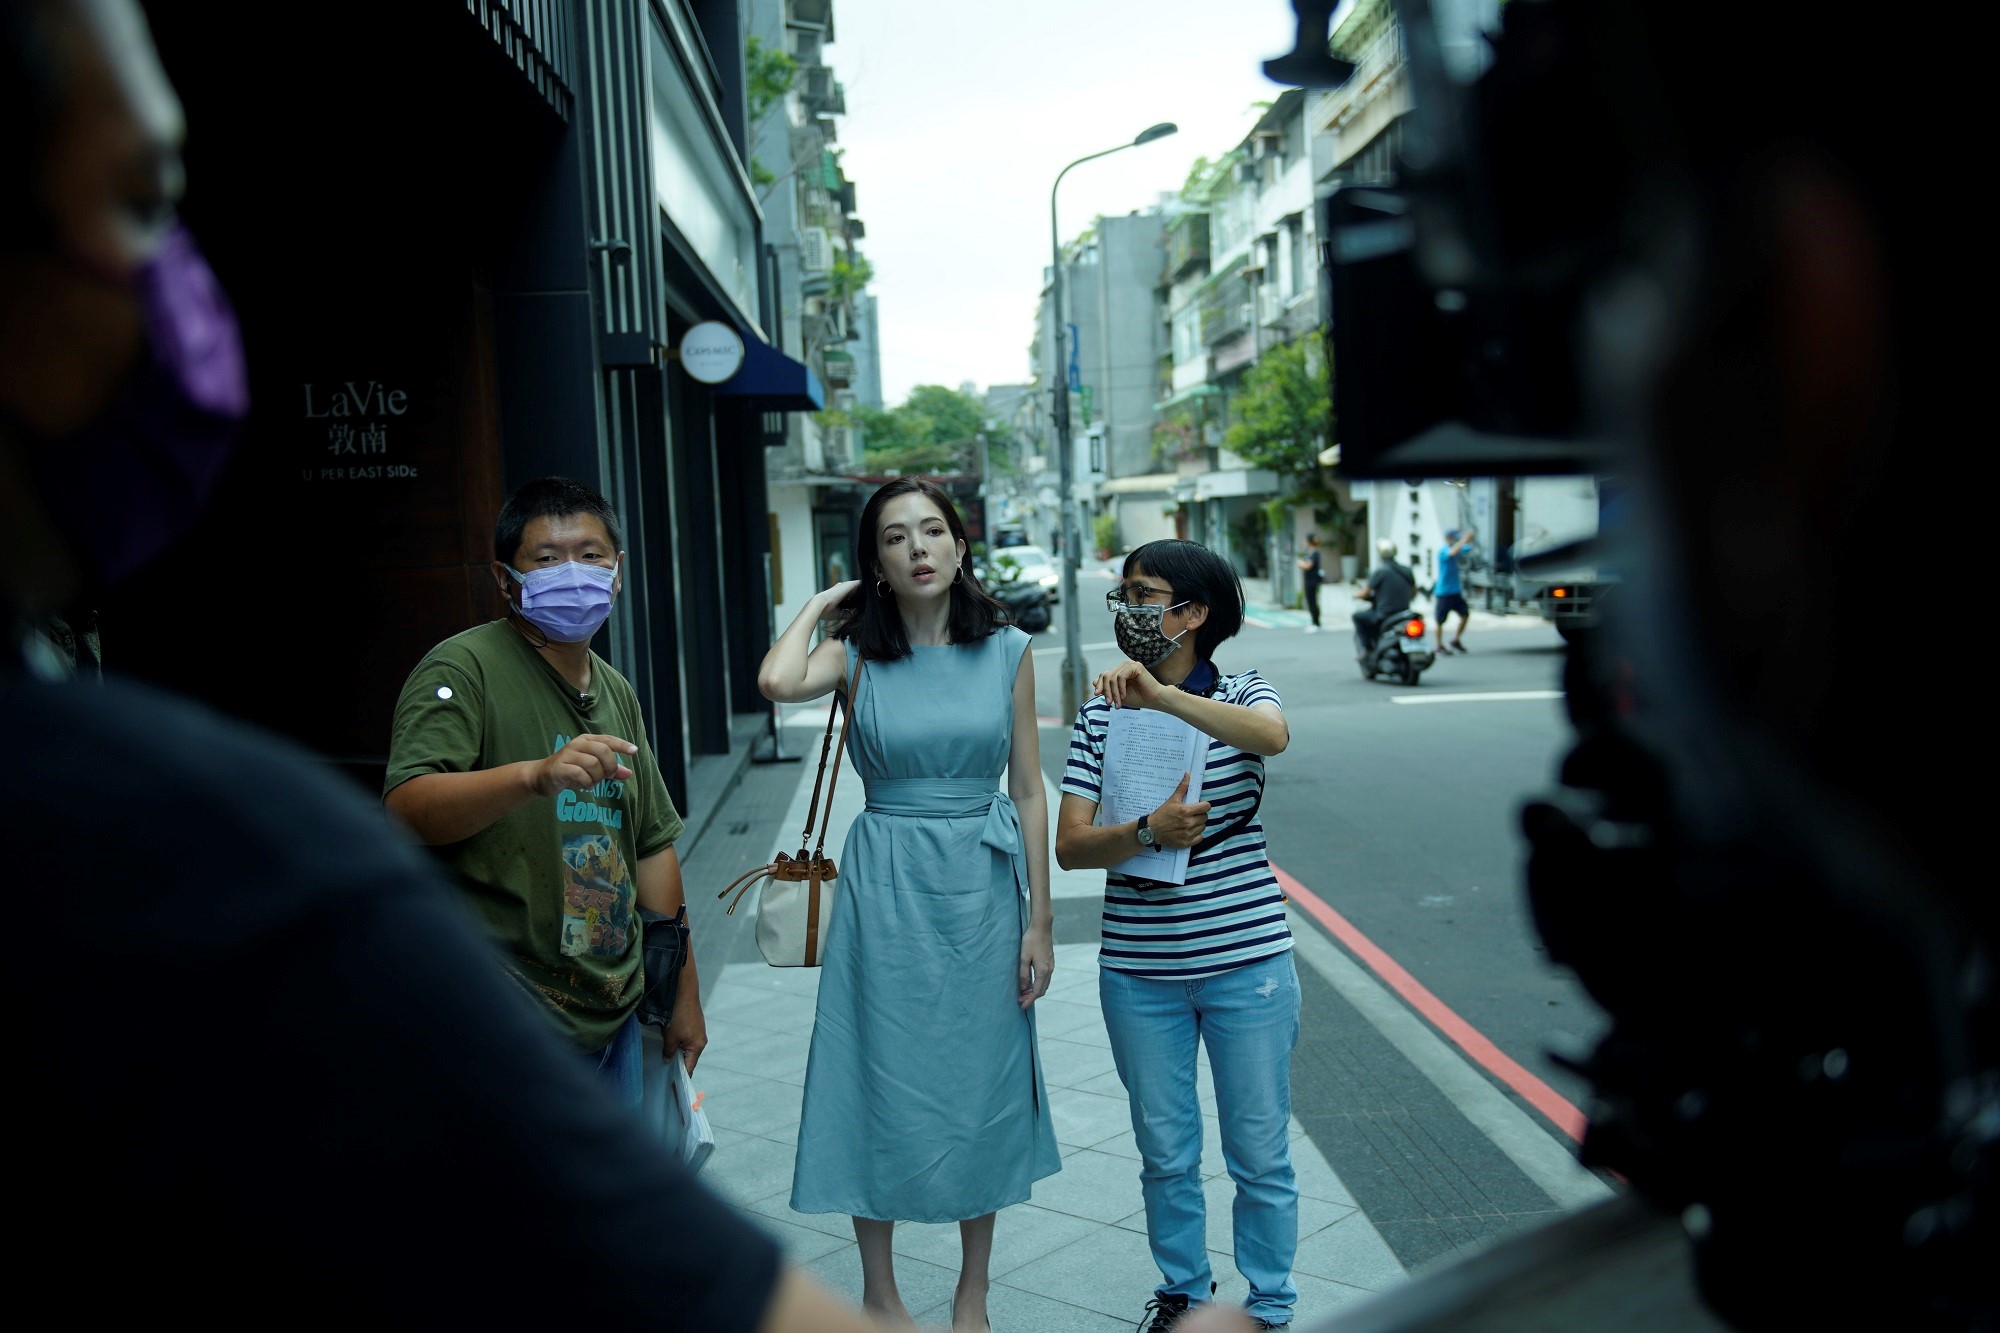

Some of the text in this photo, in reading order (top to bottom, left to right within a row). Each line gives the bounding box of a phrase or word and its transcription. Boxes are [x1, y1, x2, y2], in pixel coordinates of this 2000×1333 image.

[303, 380, 408, 419] LaVie
[328, 421, 387, 456] 敦南
[302, 467, 345, 481] UPER
[348, 466, 384, 479] EAST
